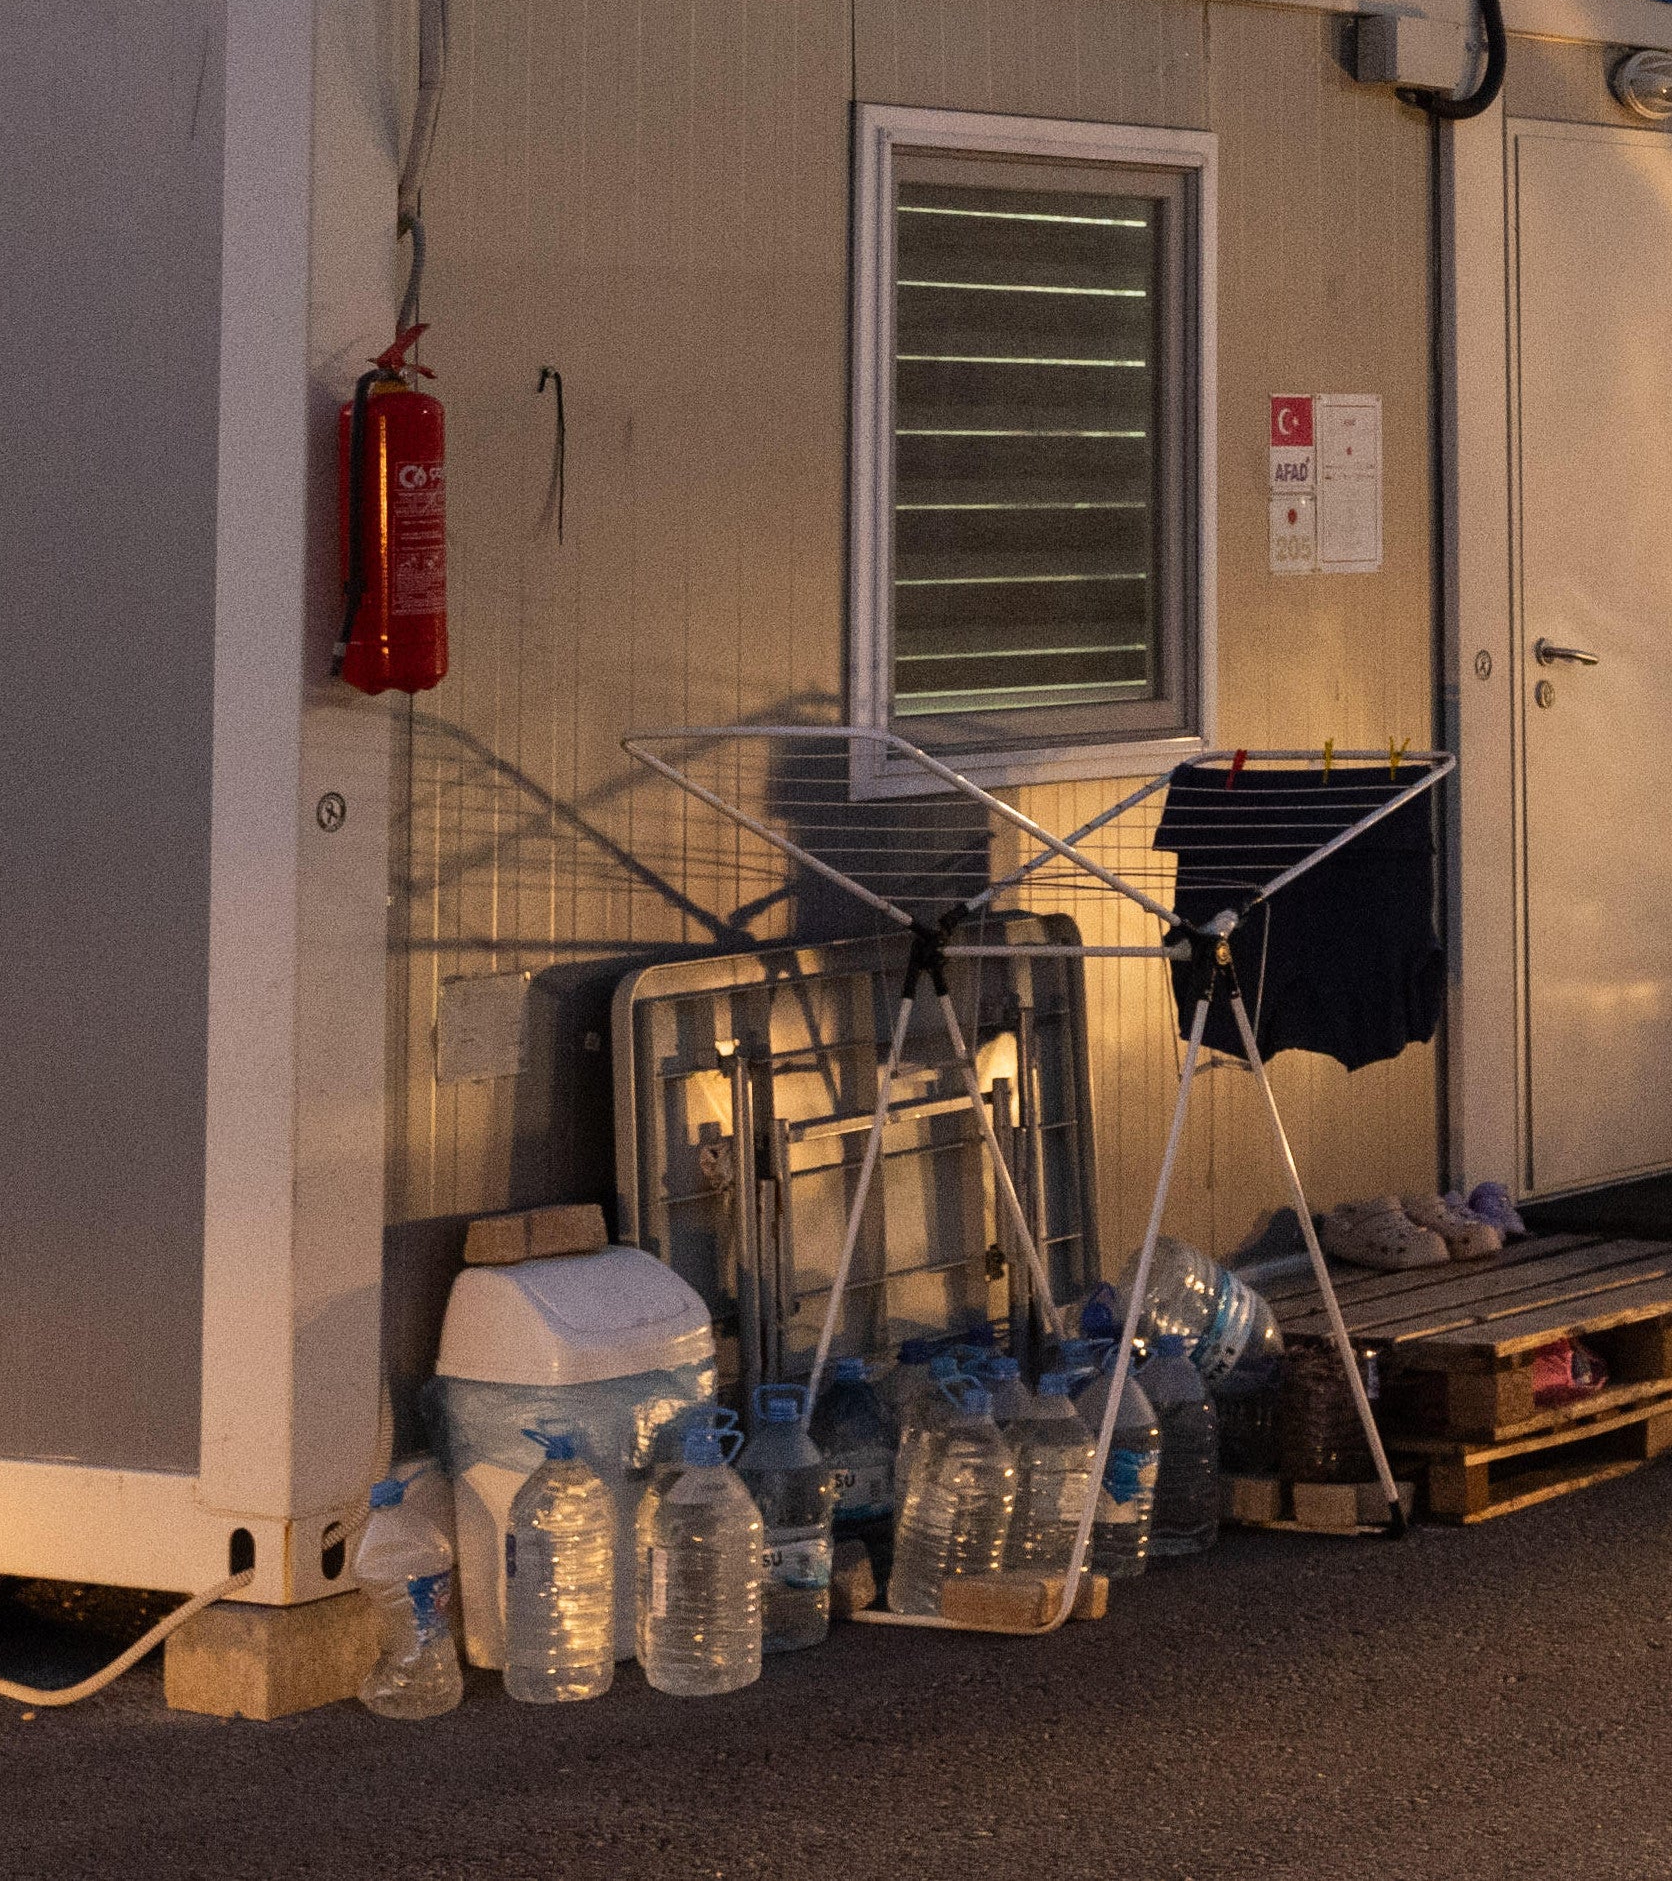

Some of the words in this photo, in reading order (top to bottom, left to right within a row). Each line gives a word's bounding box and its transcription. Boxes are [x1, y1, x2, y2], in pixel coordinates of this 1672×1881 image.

[1274, 462, 1309, 482] AFAD
[834, 1472, 856, 1488] SU
[762, 1550, 784, 1568] SU
